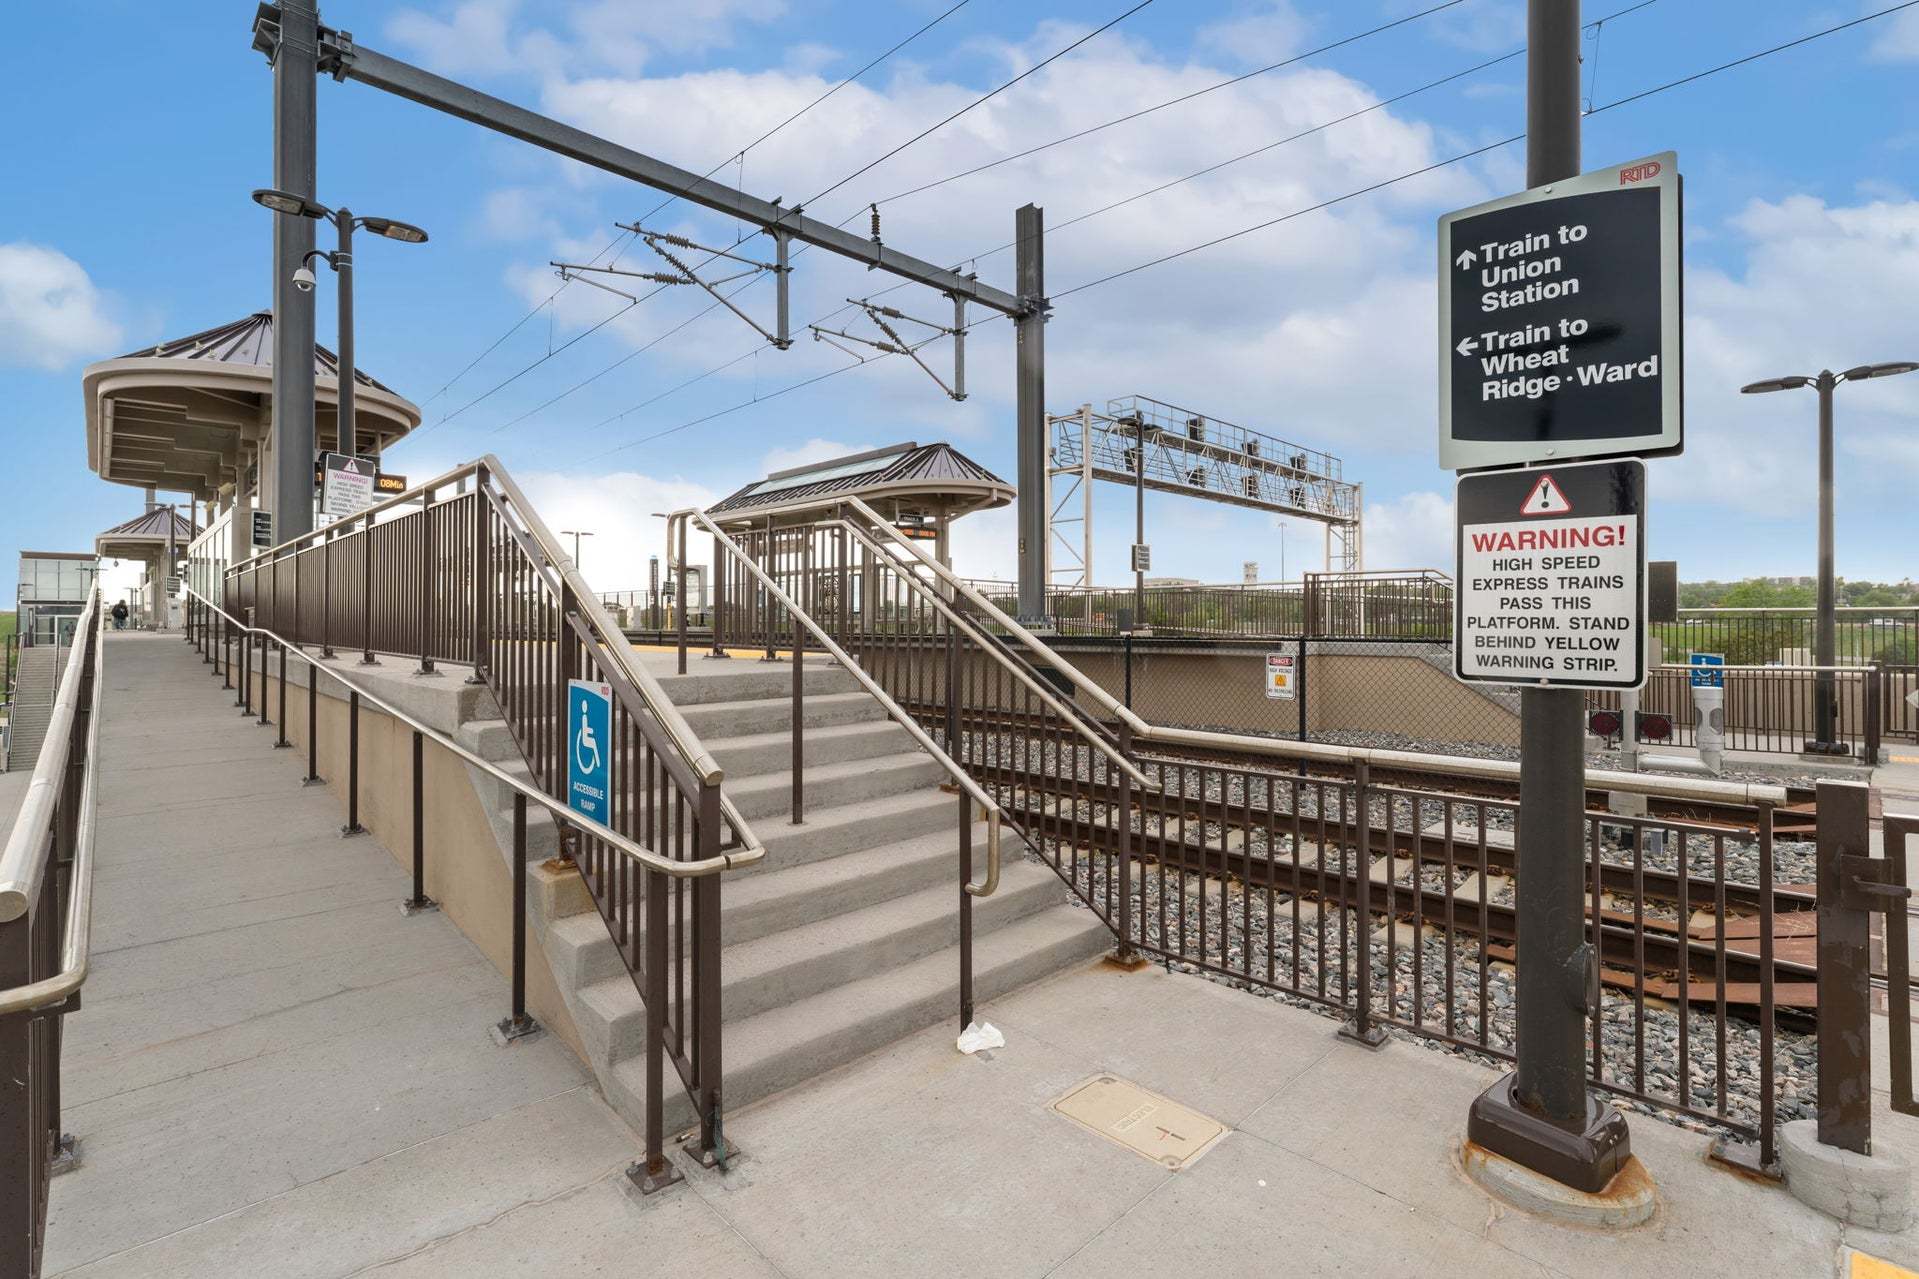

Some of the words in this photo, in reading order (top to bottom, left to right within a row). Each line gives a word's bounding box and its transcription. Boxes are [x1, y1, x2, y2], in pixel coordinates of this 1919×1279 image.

[1620, 161, 1661, 185] RTD
[1480, 232, 1550, 263] Train
[1557, 224, 1588, 245] to
[1481, 256, 1562, 287] Union
[1481, 277, 1580, 313] Station
[1481, 325, 1551, 351] Train
[1558, 318, 1588, 339] to
[1481, 344, 1570, 376] Wheat
[1482, 374, 1561, 401] Ridge
[1577, 354, 1658, 387] Ward
[1472, 525, 1625, 552] WARNING!
[1492, 558, 1533, 571] HIGH
[1541, 555, 1601, 570] SPEED
[1472, 577, 1549, 591] EXPRESS
[1557, 575, 1624, 589] TRAINS
[1500, 597, 1543, 609] PASS
[1552, 596, 1592, 610] THIS
[1467, 616, 1560, 629] PLATFORM.
[1569, 617, 1630, 631] STAND
[1475, 636, 1536, 649] BEHIND
[1545, 637, 1620, 651] YELLOW
[1476, 655, 1554, 669] WARNING
[1563, 657, 1618, 672] STRIP.
[573, 781, 604, 800] ACCESSIBLE
[580, 799, 596, 812] RAMP
